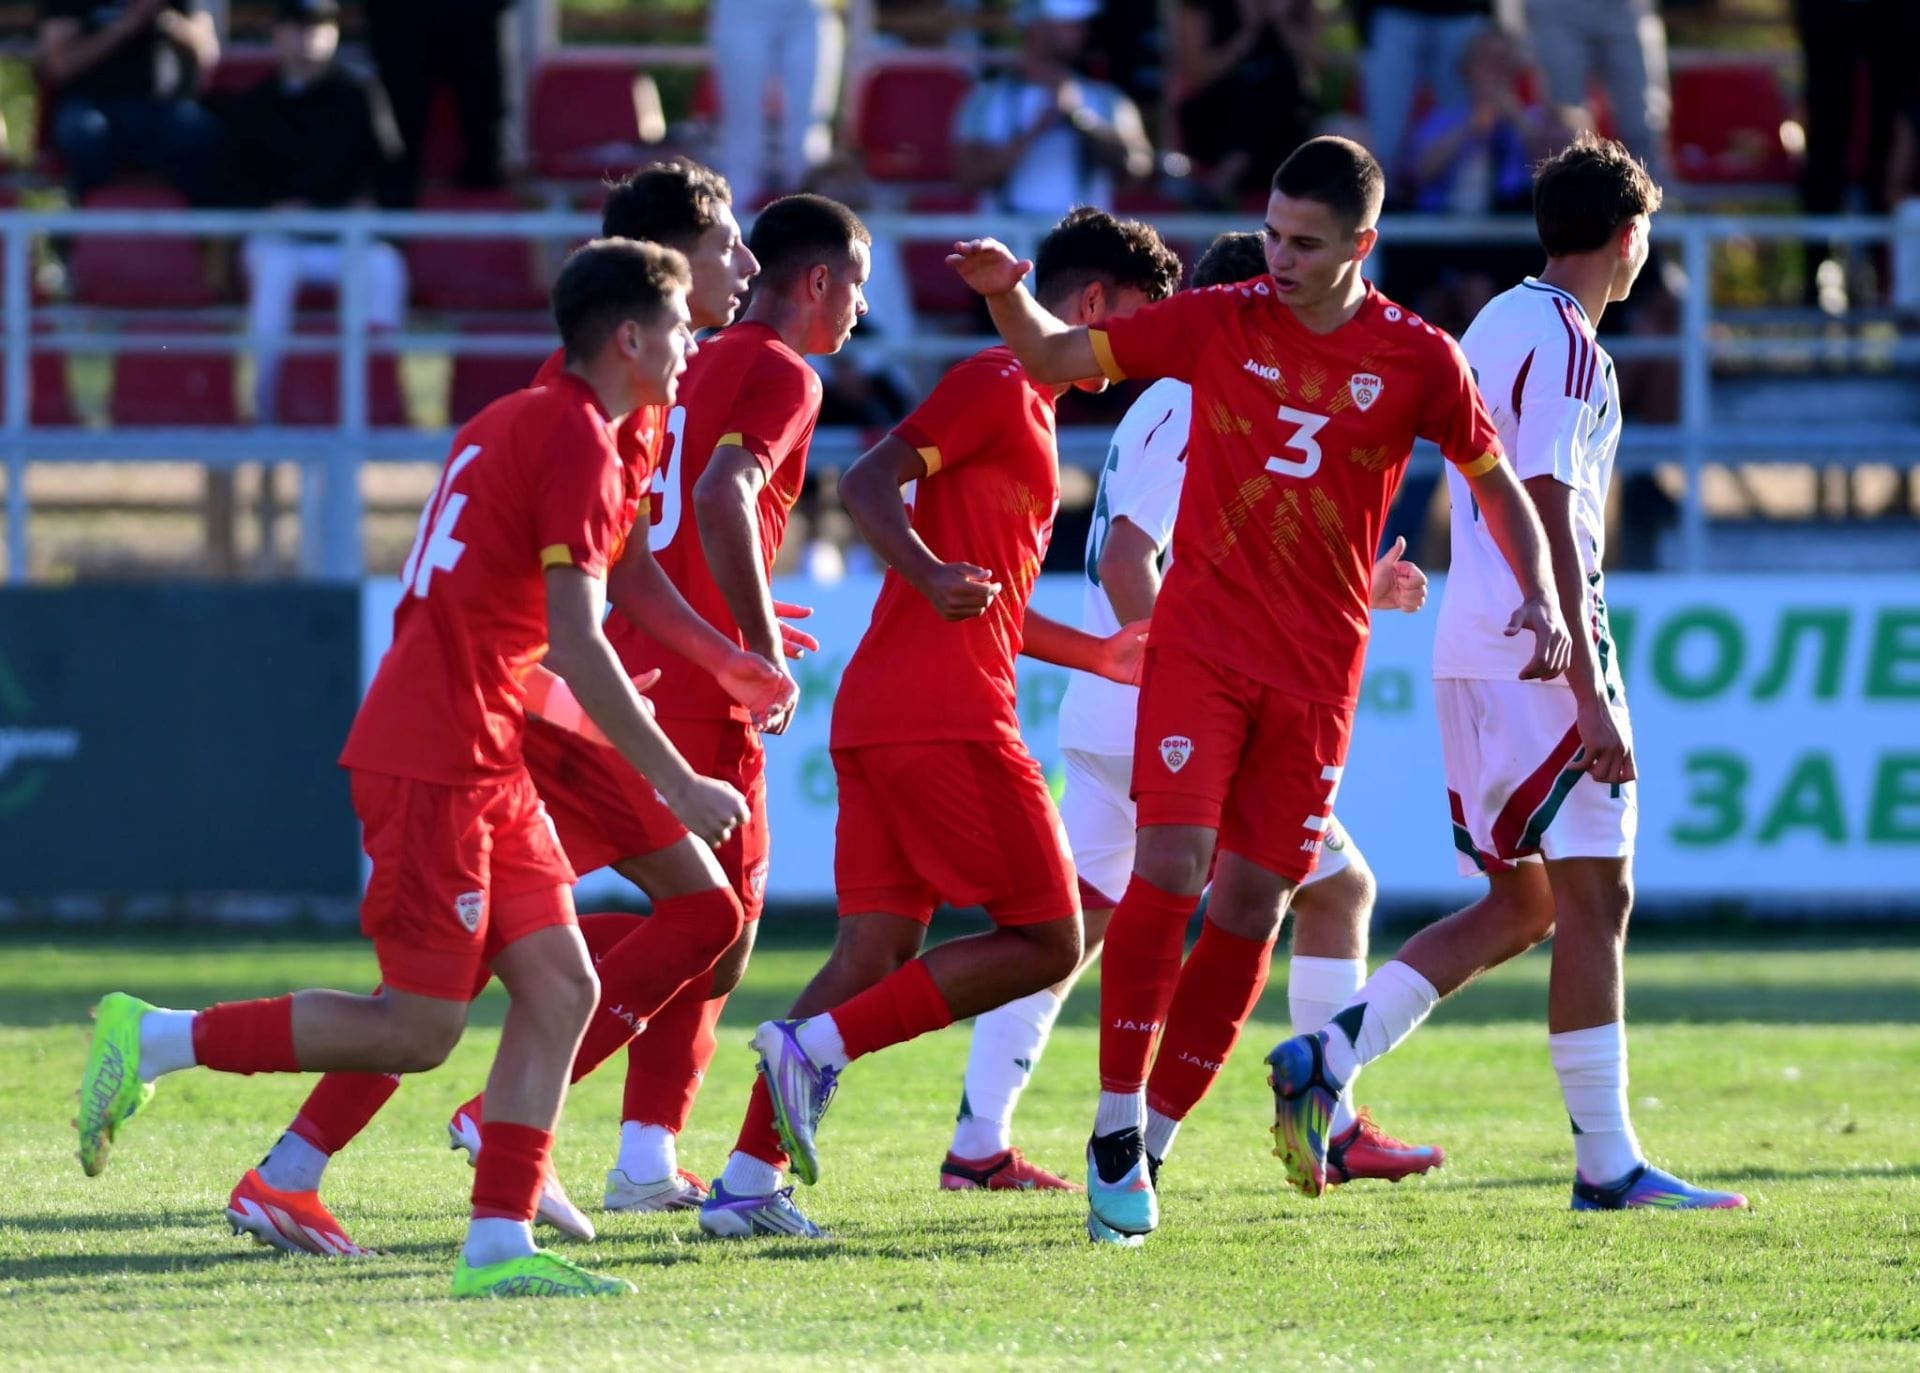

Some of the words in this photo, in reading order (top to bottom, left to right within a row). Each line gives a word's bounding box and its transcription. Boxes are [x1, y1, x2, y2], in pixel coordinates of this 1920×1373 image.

[1243, 358, 1281, 381] JAKO
[1264, 404, 1330, 479] 3
[1113, 1019, 1160, 1032] JAKO
[1178, 1052, 1223, 1072] JAKO
